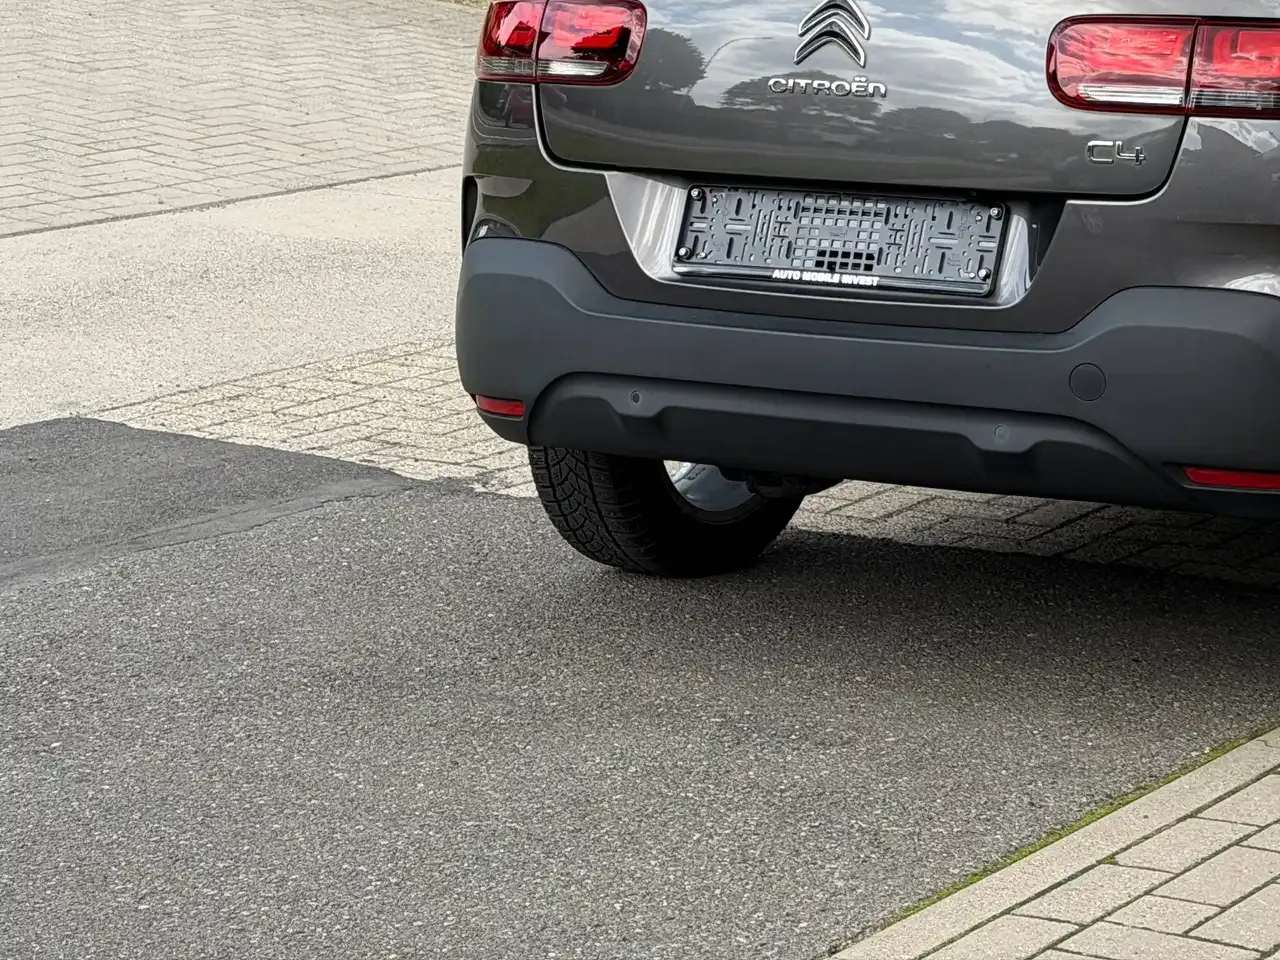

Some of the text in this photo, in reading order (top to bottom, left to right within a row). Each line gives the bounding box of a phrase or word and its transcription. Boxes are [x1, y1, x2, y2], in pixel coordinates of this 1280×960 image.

[1086, 140, 1146, 166] C4
[772, 269, 880, 287] AUTO MOBILE INVEST
